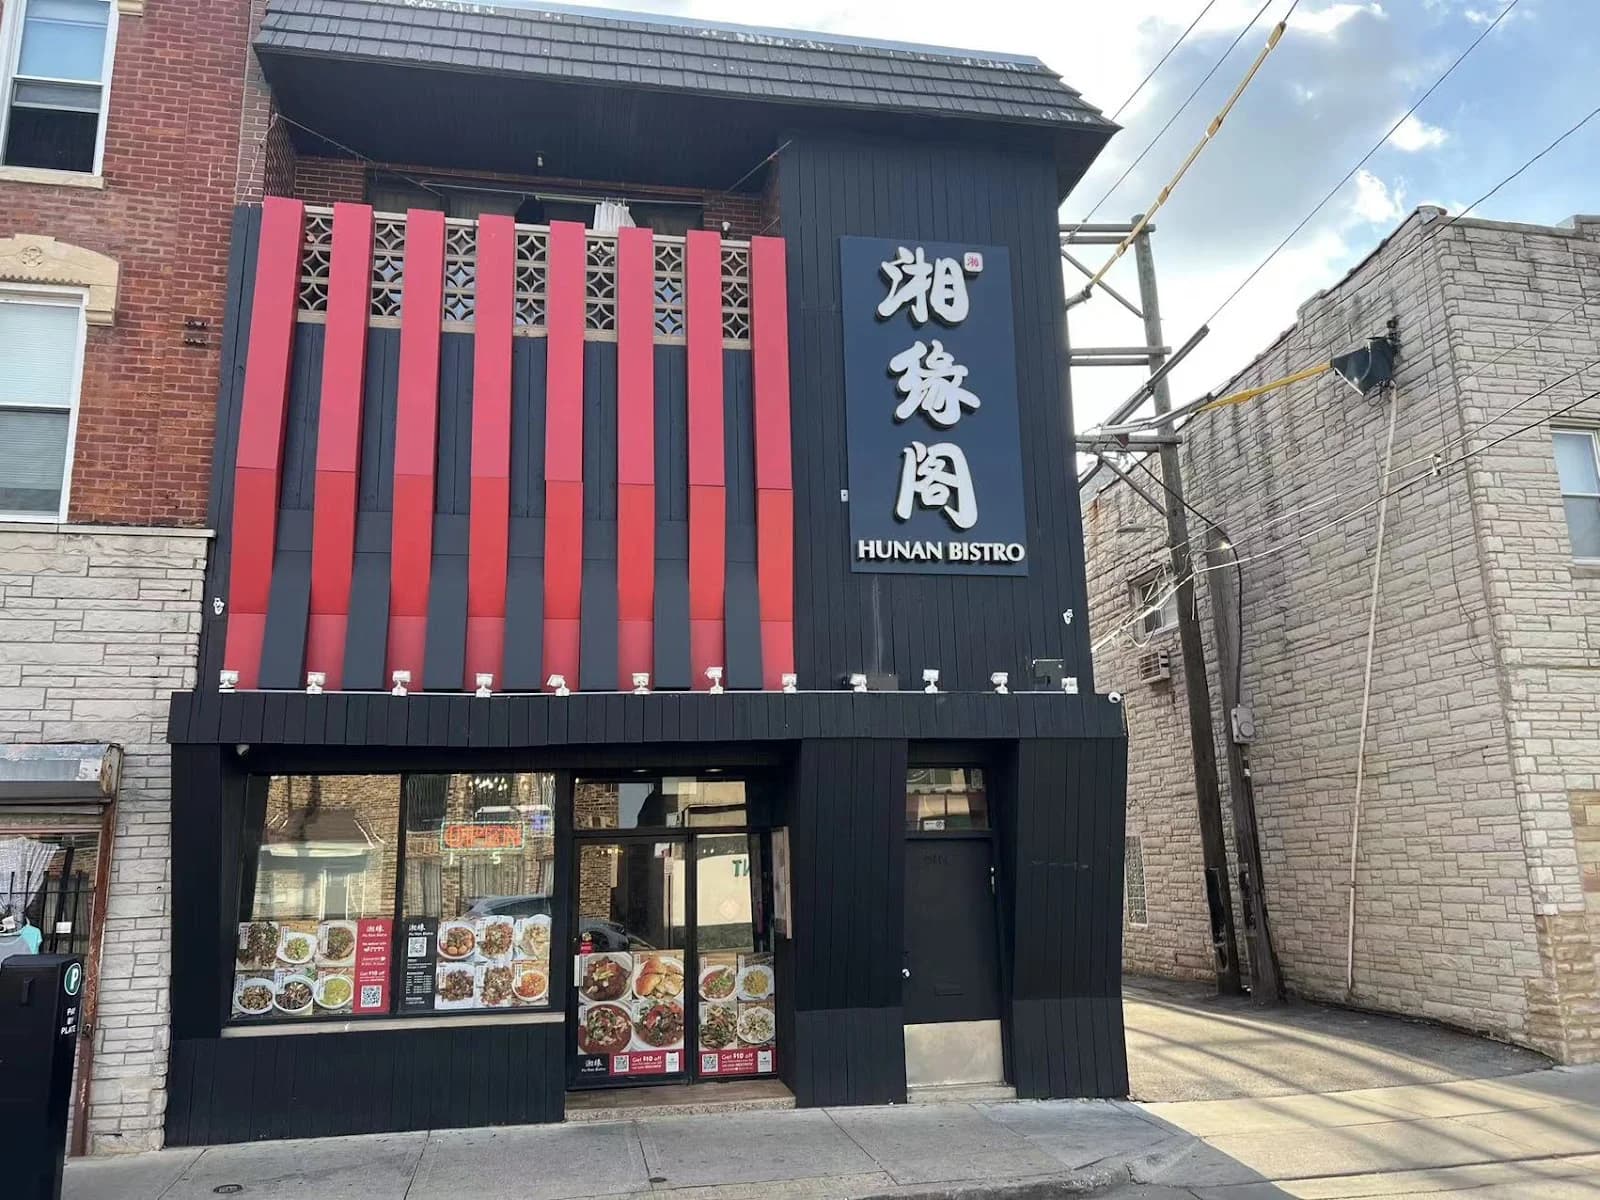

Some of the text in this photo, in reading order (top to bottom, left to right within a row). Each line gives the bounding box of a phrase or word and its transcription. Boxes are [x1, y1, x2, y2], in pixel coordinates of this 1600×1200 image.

[858, 540, 1025, 561] HUNAN BISTRO
[445, 824, 522, 848] OPEN
[70, 968, 79, 990] P
[61, 1025, 76, 1035] PLATE
